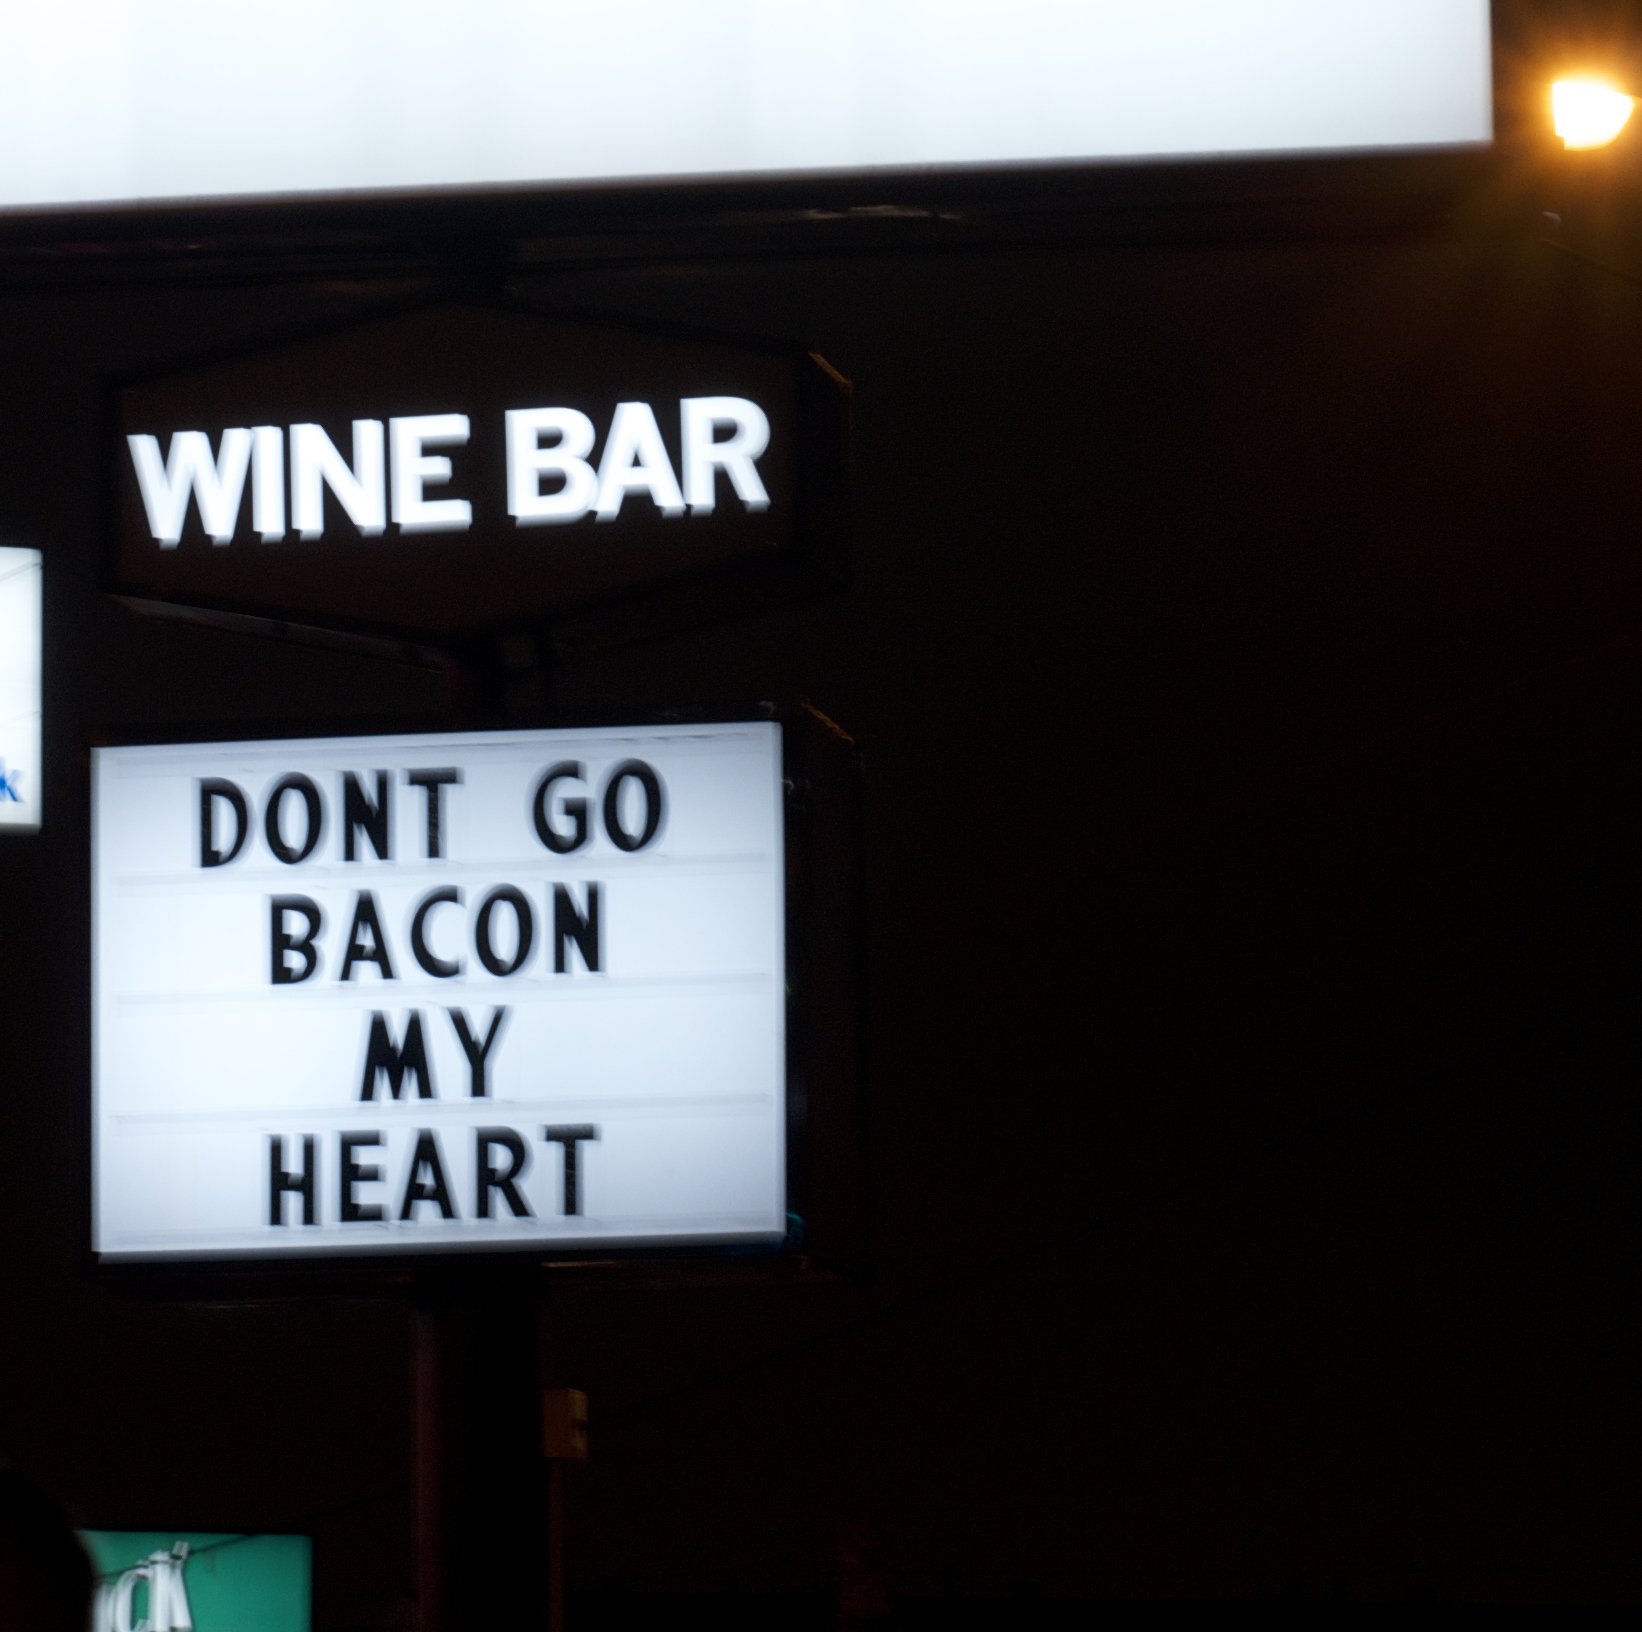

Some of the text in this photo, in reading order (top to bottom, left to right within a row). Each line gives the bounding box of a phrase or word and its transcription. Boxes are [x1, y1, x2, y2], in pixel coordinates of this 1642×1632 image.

[125, 395, 773, 552] WINE BAR
[195, 756, 668, 871] DONT GO
[265, 878, 608, 986] BACON
[355, 1002, 515, 1102] MY
[263, 1121, 602, 1228] HEART
